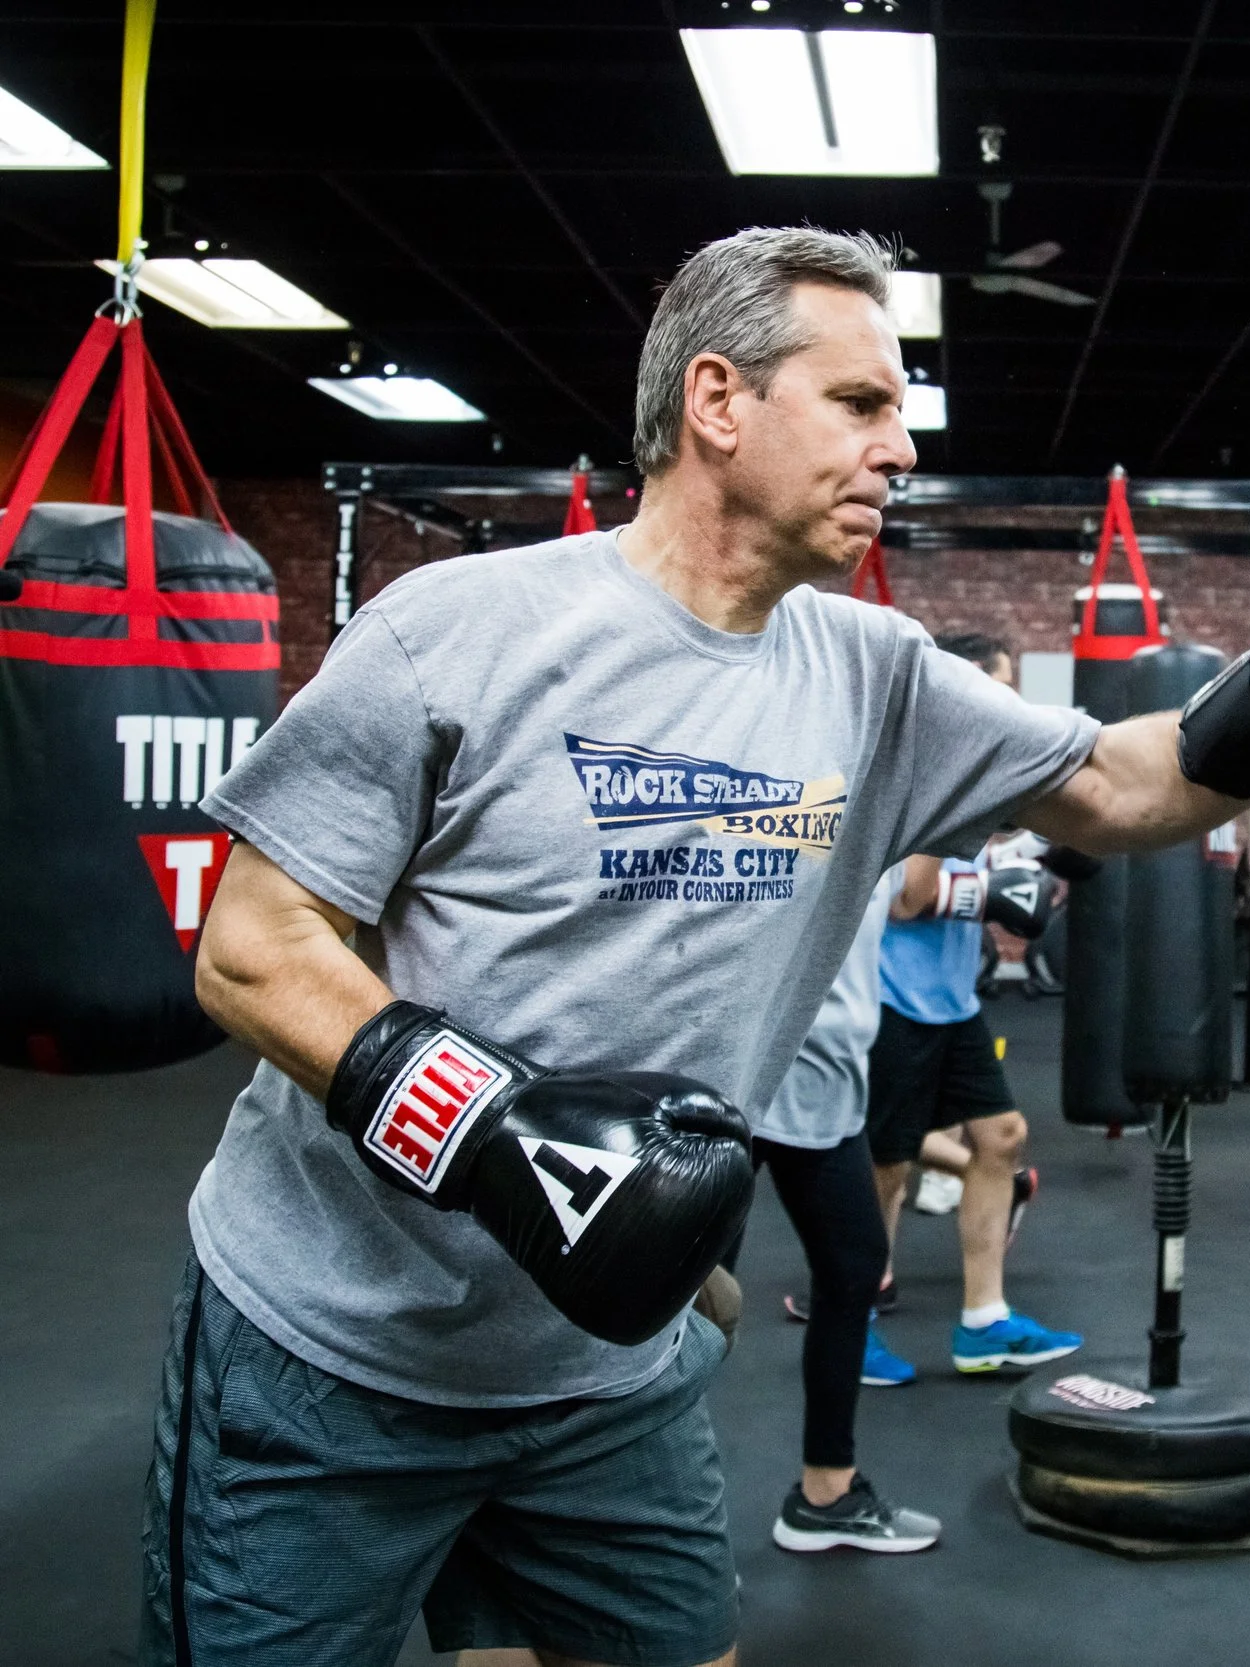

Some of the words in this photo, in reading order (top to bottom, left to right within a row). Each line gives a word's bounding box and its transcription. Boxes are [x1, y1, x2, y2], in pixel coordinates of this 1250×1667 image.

[581, 764, 687, 806] ROCK
[692, 772, 802, 805] STEADY
[722, 810, 843, 842] BOXING
[599, 846, 725, 879] KANSAS
[734, 847, 800, 877] CITY
[165, 840, 213, 931] T
[598, 888, 616, 900] at
[683, 880, 745, 902] CORNER
[746, 879, 795, 902] FITNESS
[381, 1050, 492, 1174] TITLE
[530, 1141, 613, 1218] T
